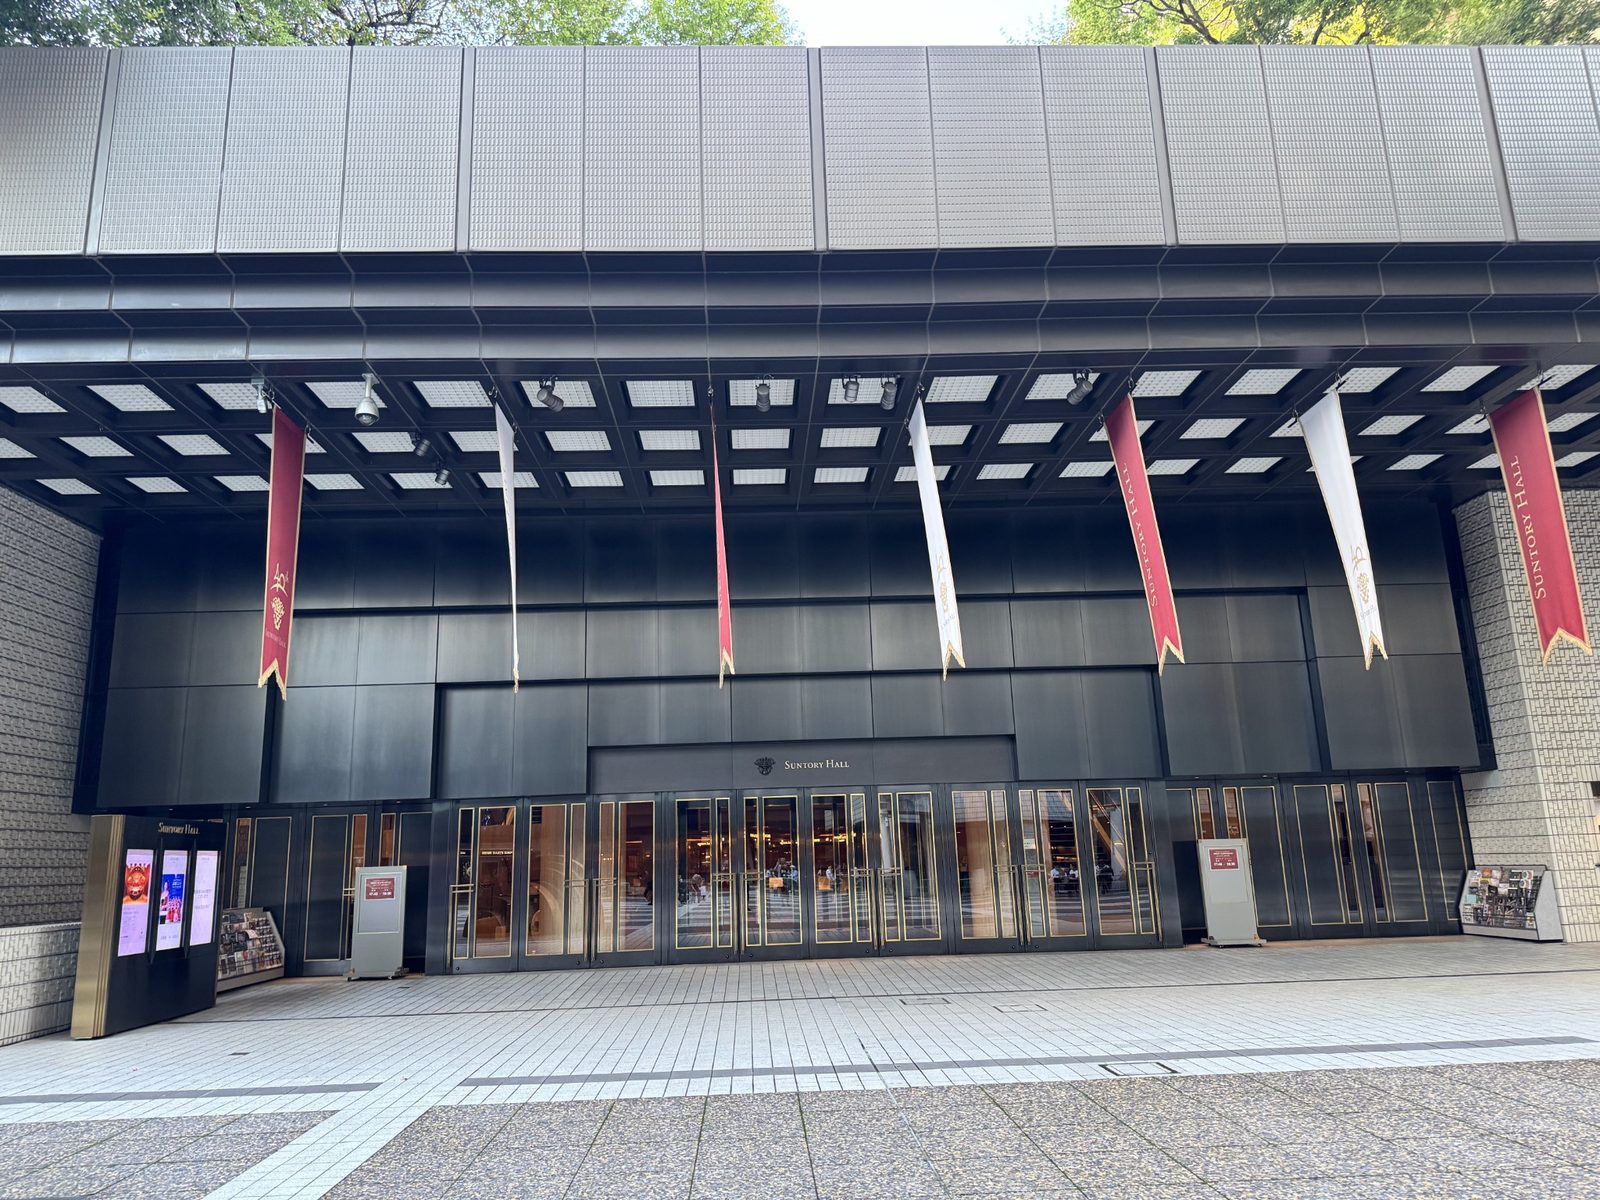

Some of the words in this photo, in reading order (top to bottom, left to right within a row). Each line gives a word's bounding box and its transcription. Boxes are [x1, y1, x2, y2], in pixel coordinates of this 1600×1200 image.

[1121, 462, 1139, 516] HALL
[1510, 455, 1529, 510] HALL
[1135, 521, 1158, 607] SUNTORY
[1522, 513, 1547, 600] SUNTORY
[784, 760, 824, 770] SUNTORY
[826, 759, 850, 768] HALL
